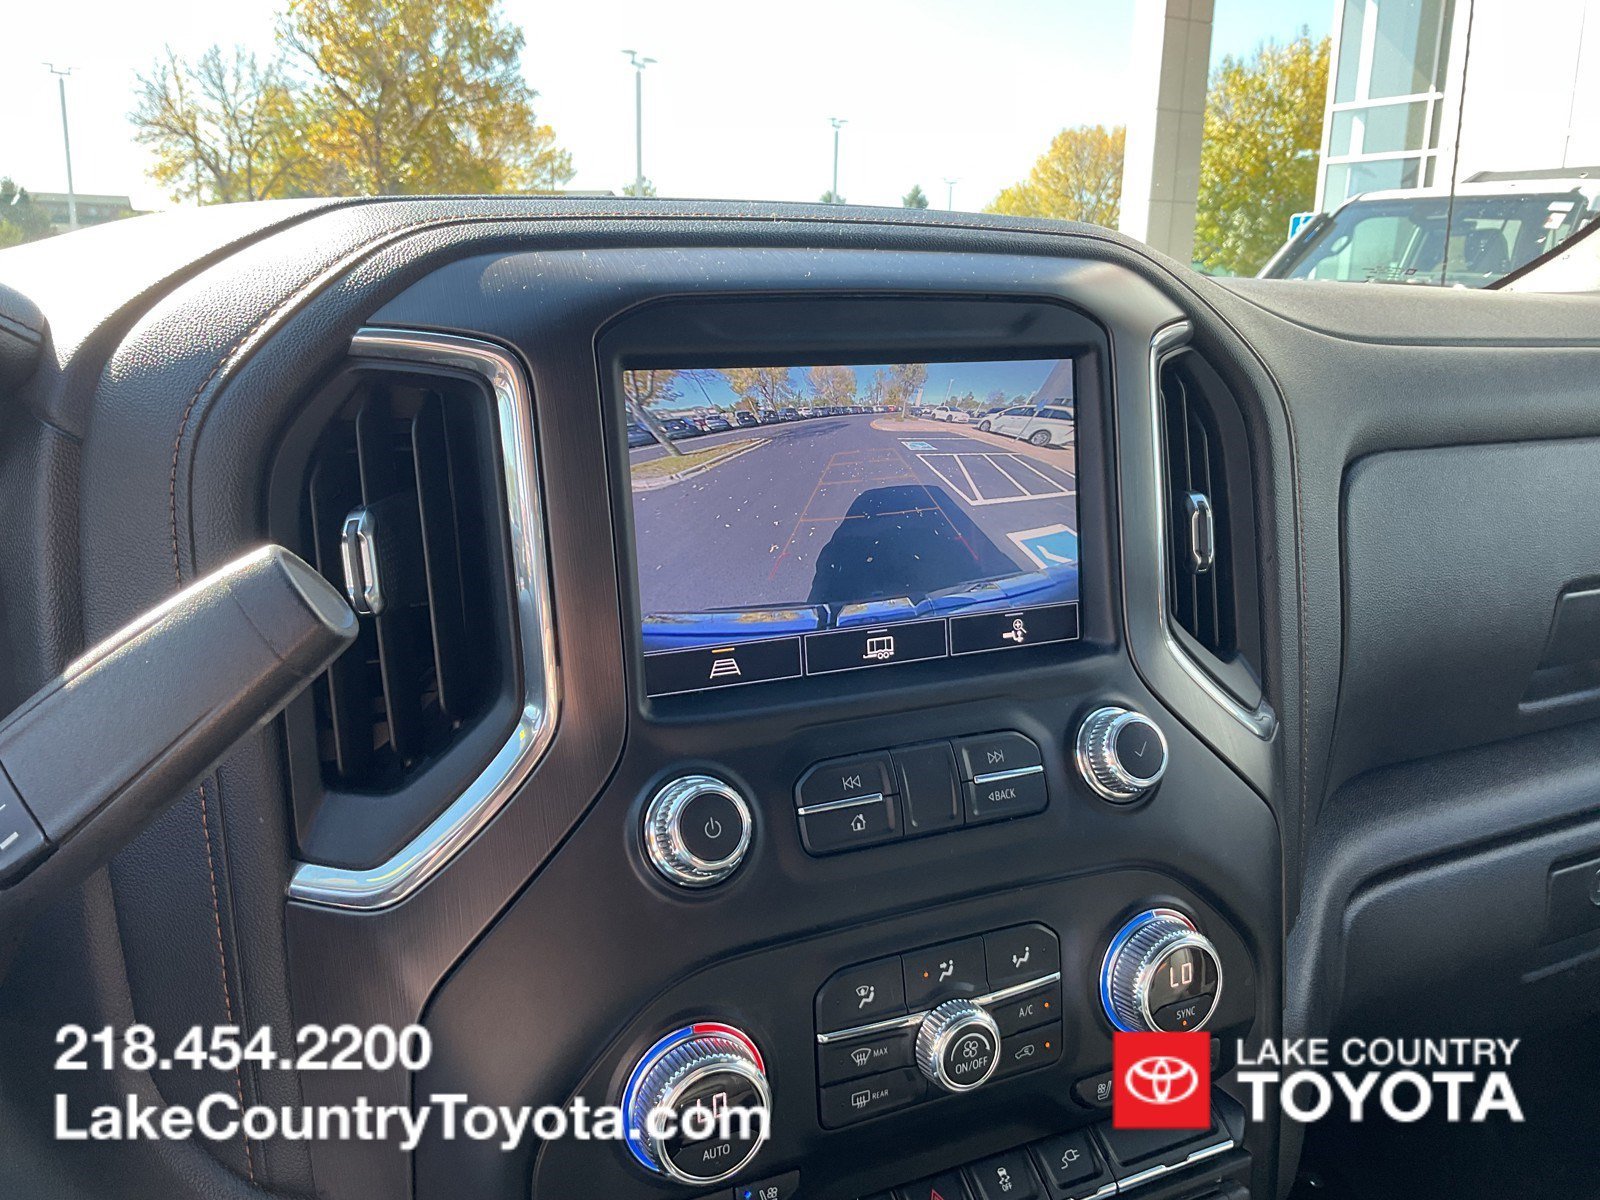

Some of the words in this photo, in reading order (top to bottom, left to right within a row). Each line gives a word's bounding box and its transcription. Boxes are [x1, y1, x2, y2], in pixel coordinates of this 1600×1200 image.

[994, 788, 1016, 801] BACK
[1170, 962, 1192, 988] LO
[1018, 1004, 1034, 1018] A/C
[1176, 1005, 1196, 1020] SYNC
[872, 1047, 889, 1058] MAX
[955, 1056, 988, 1075] ON/OFF
[871, 1089, 889, 1100] REAR
[702, 1143, 731, 1162] AUTO
